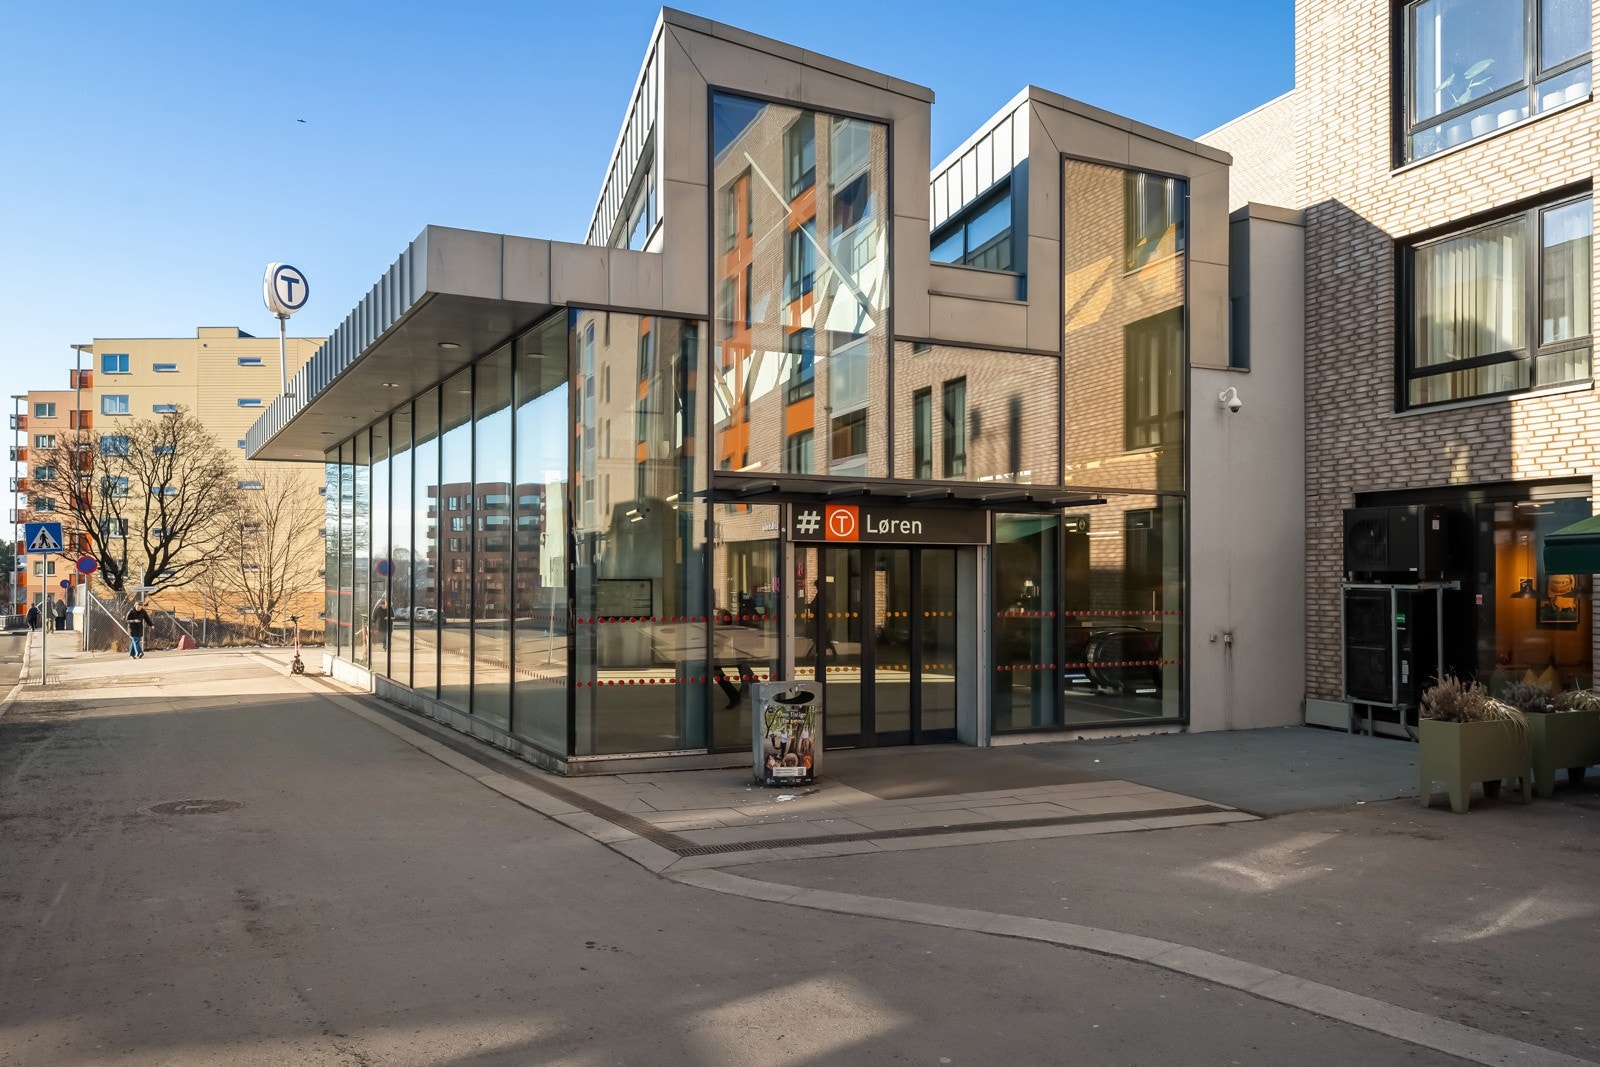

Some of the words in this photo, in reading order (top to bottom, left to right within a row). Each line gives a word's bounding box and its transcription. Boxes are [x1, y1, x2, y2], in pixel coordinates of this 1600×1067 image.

[281, 275, 299, 302] T
[835, 515, 849, 533] T
[866, 514, 922, 534] Løren
